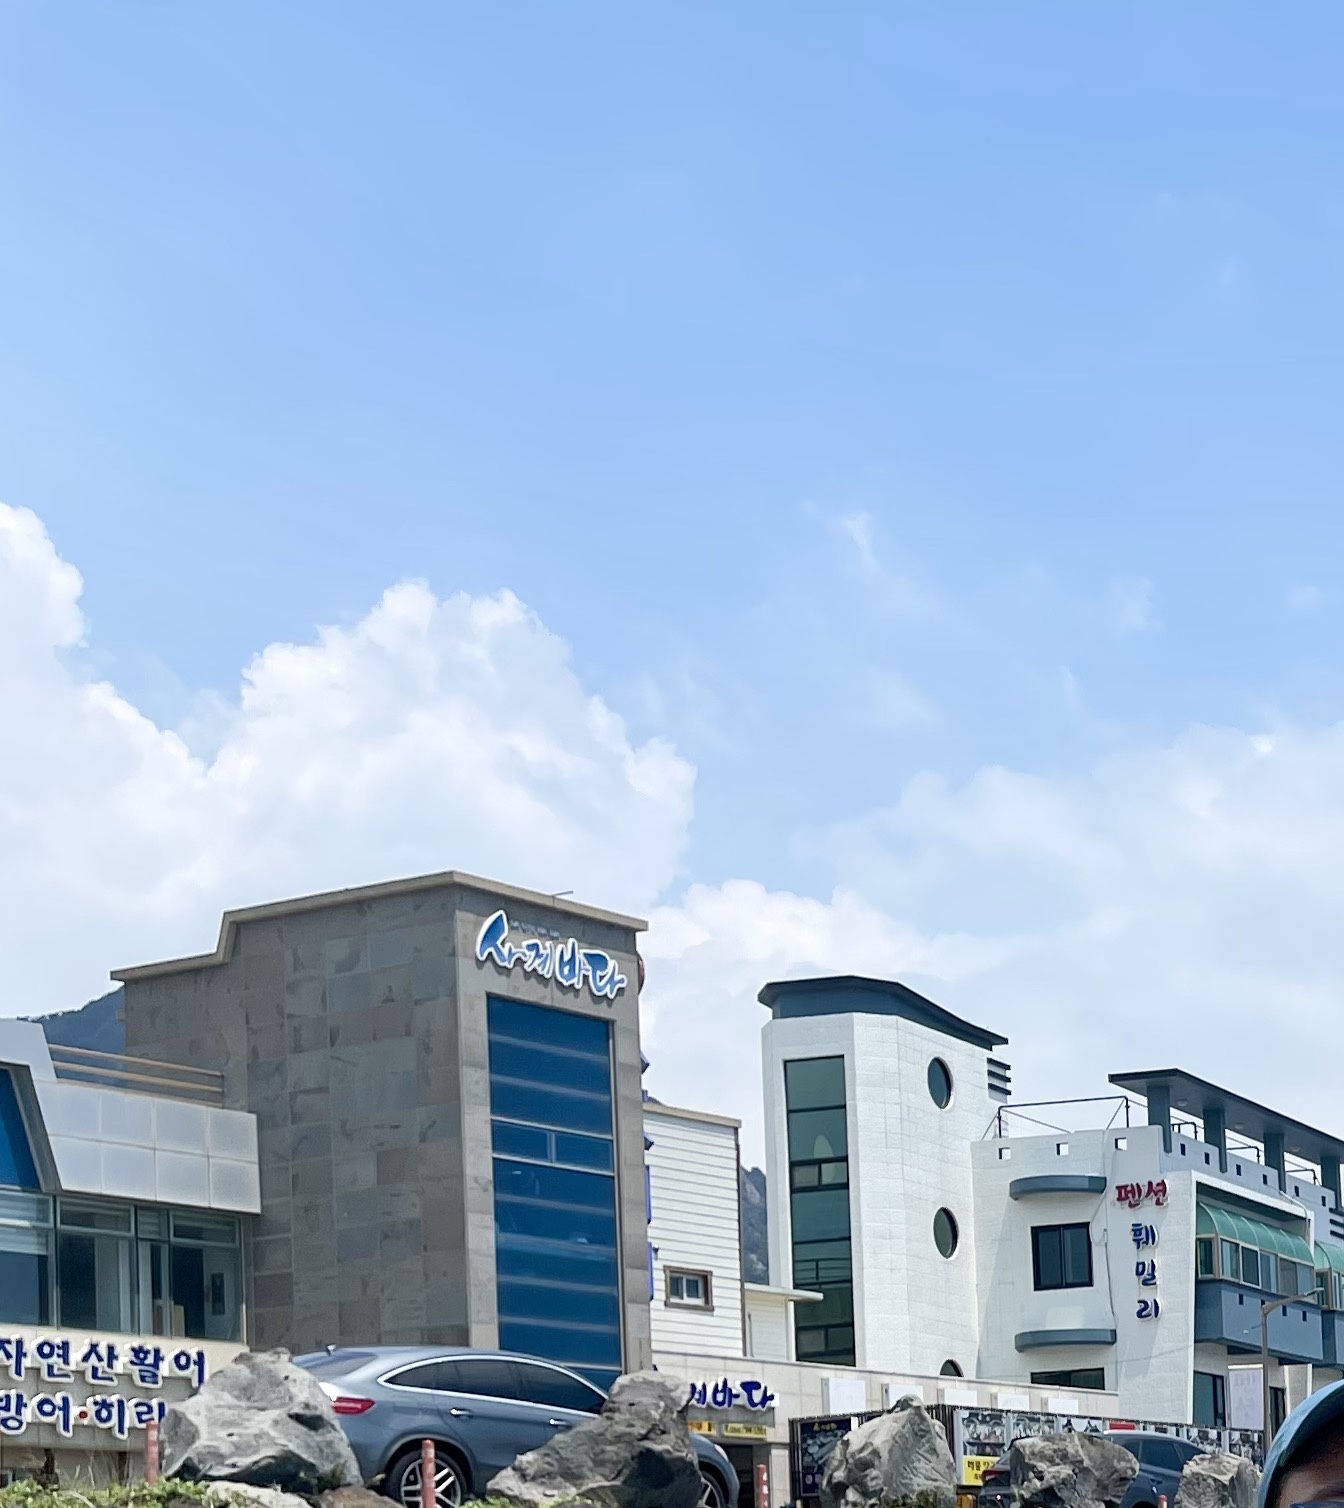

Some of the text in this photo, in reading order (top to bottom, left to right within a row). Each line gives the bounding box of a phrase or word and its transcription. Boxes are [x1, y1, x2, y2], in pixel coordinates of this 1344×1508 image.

[1115, 1179, 1168, 1208] 펜션
[1131, 1222, 1161, 1320] 훼밀리
[0, 1336, 206, 1385] 자연산활어
